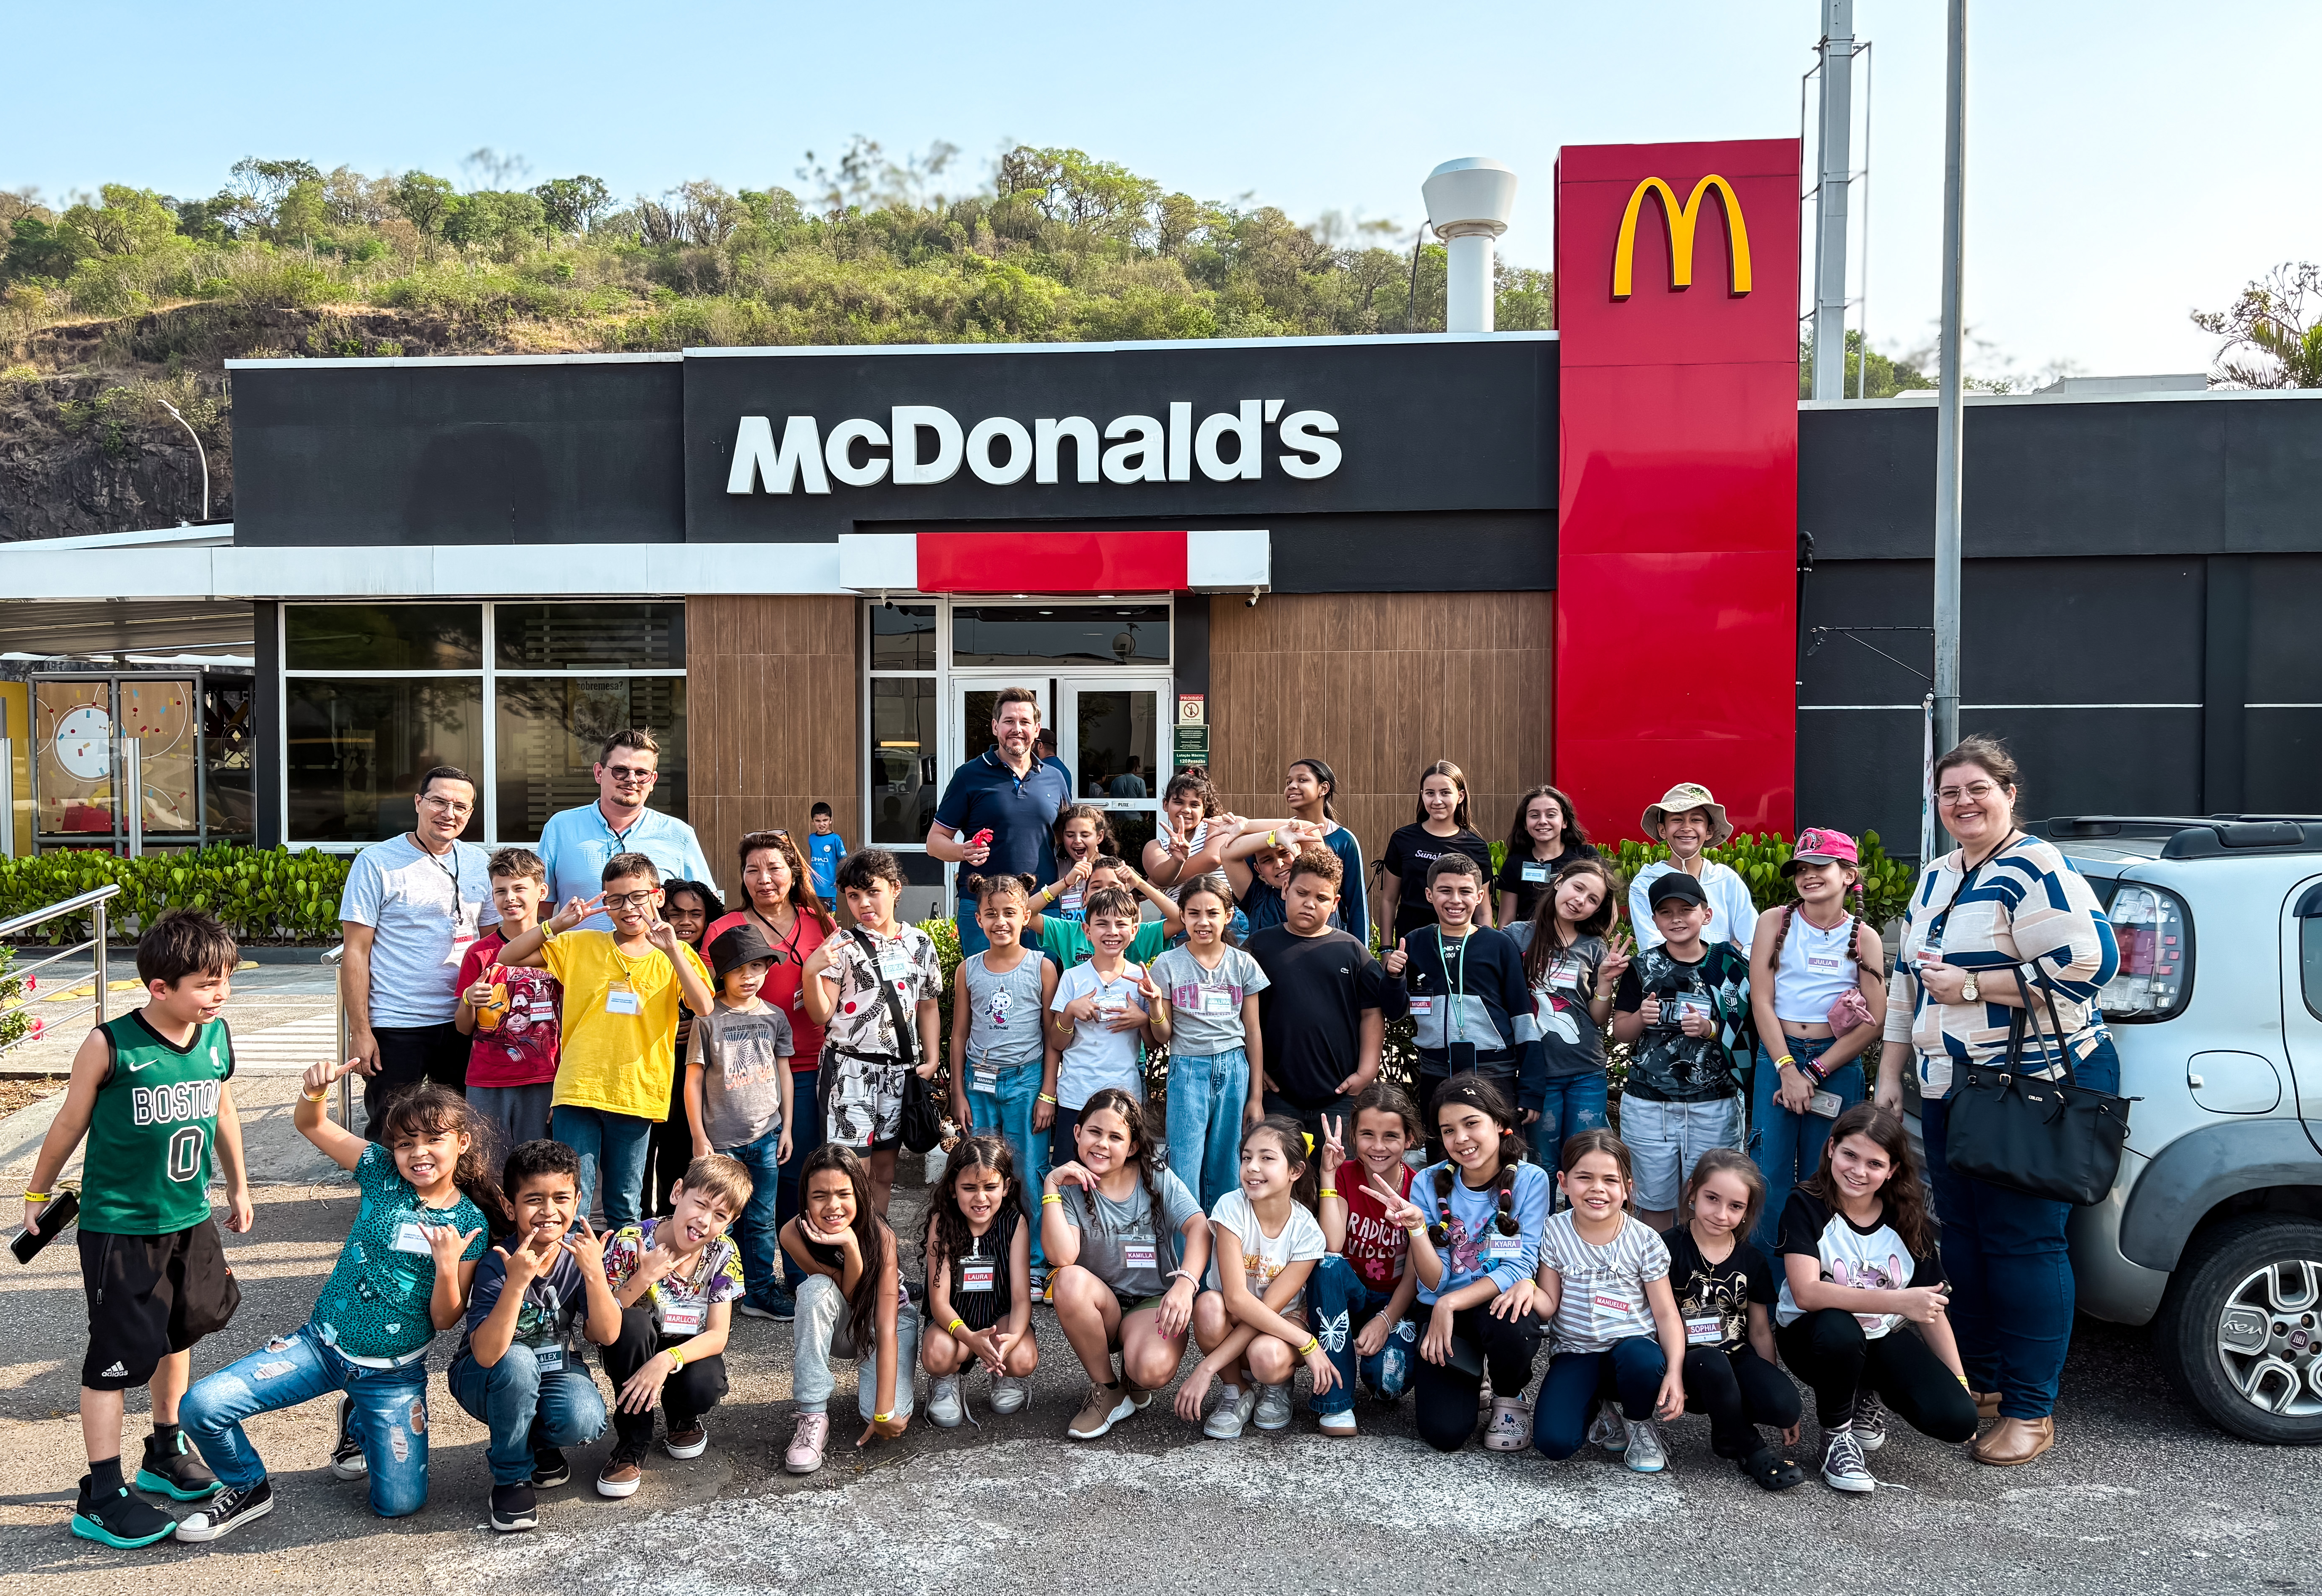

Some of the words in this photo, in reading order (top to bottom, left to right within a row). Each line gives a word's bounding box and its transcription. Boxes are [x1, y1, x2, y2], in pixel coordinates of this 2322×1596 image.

[727, 399, 1342, 494] McDonald's
[577, 681, 623, 691] sobremesa?
[132, 1079, 222, 1126] BOSTON
[168, 1126, 205, 1182] 0
[1597, 1297, 1627, 1309] MANUELLY
[666, 1315, 697, 1324] MARLLON
[1690, 1324, 1717, 1333] SOPHIA
[2292, 1334, 2306, 1345] FIAT
[539, 1352, 557, 1362] ALEX
